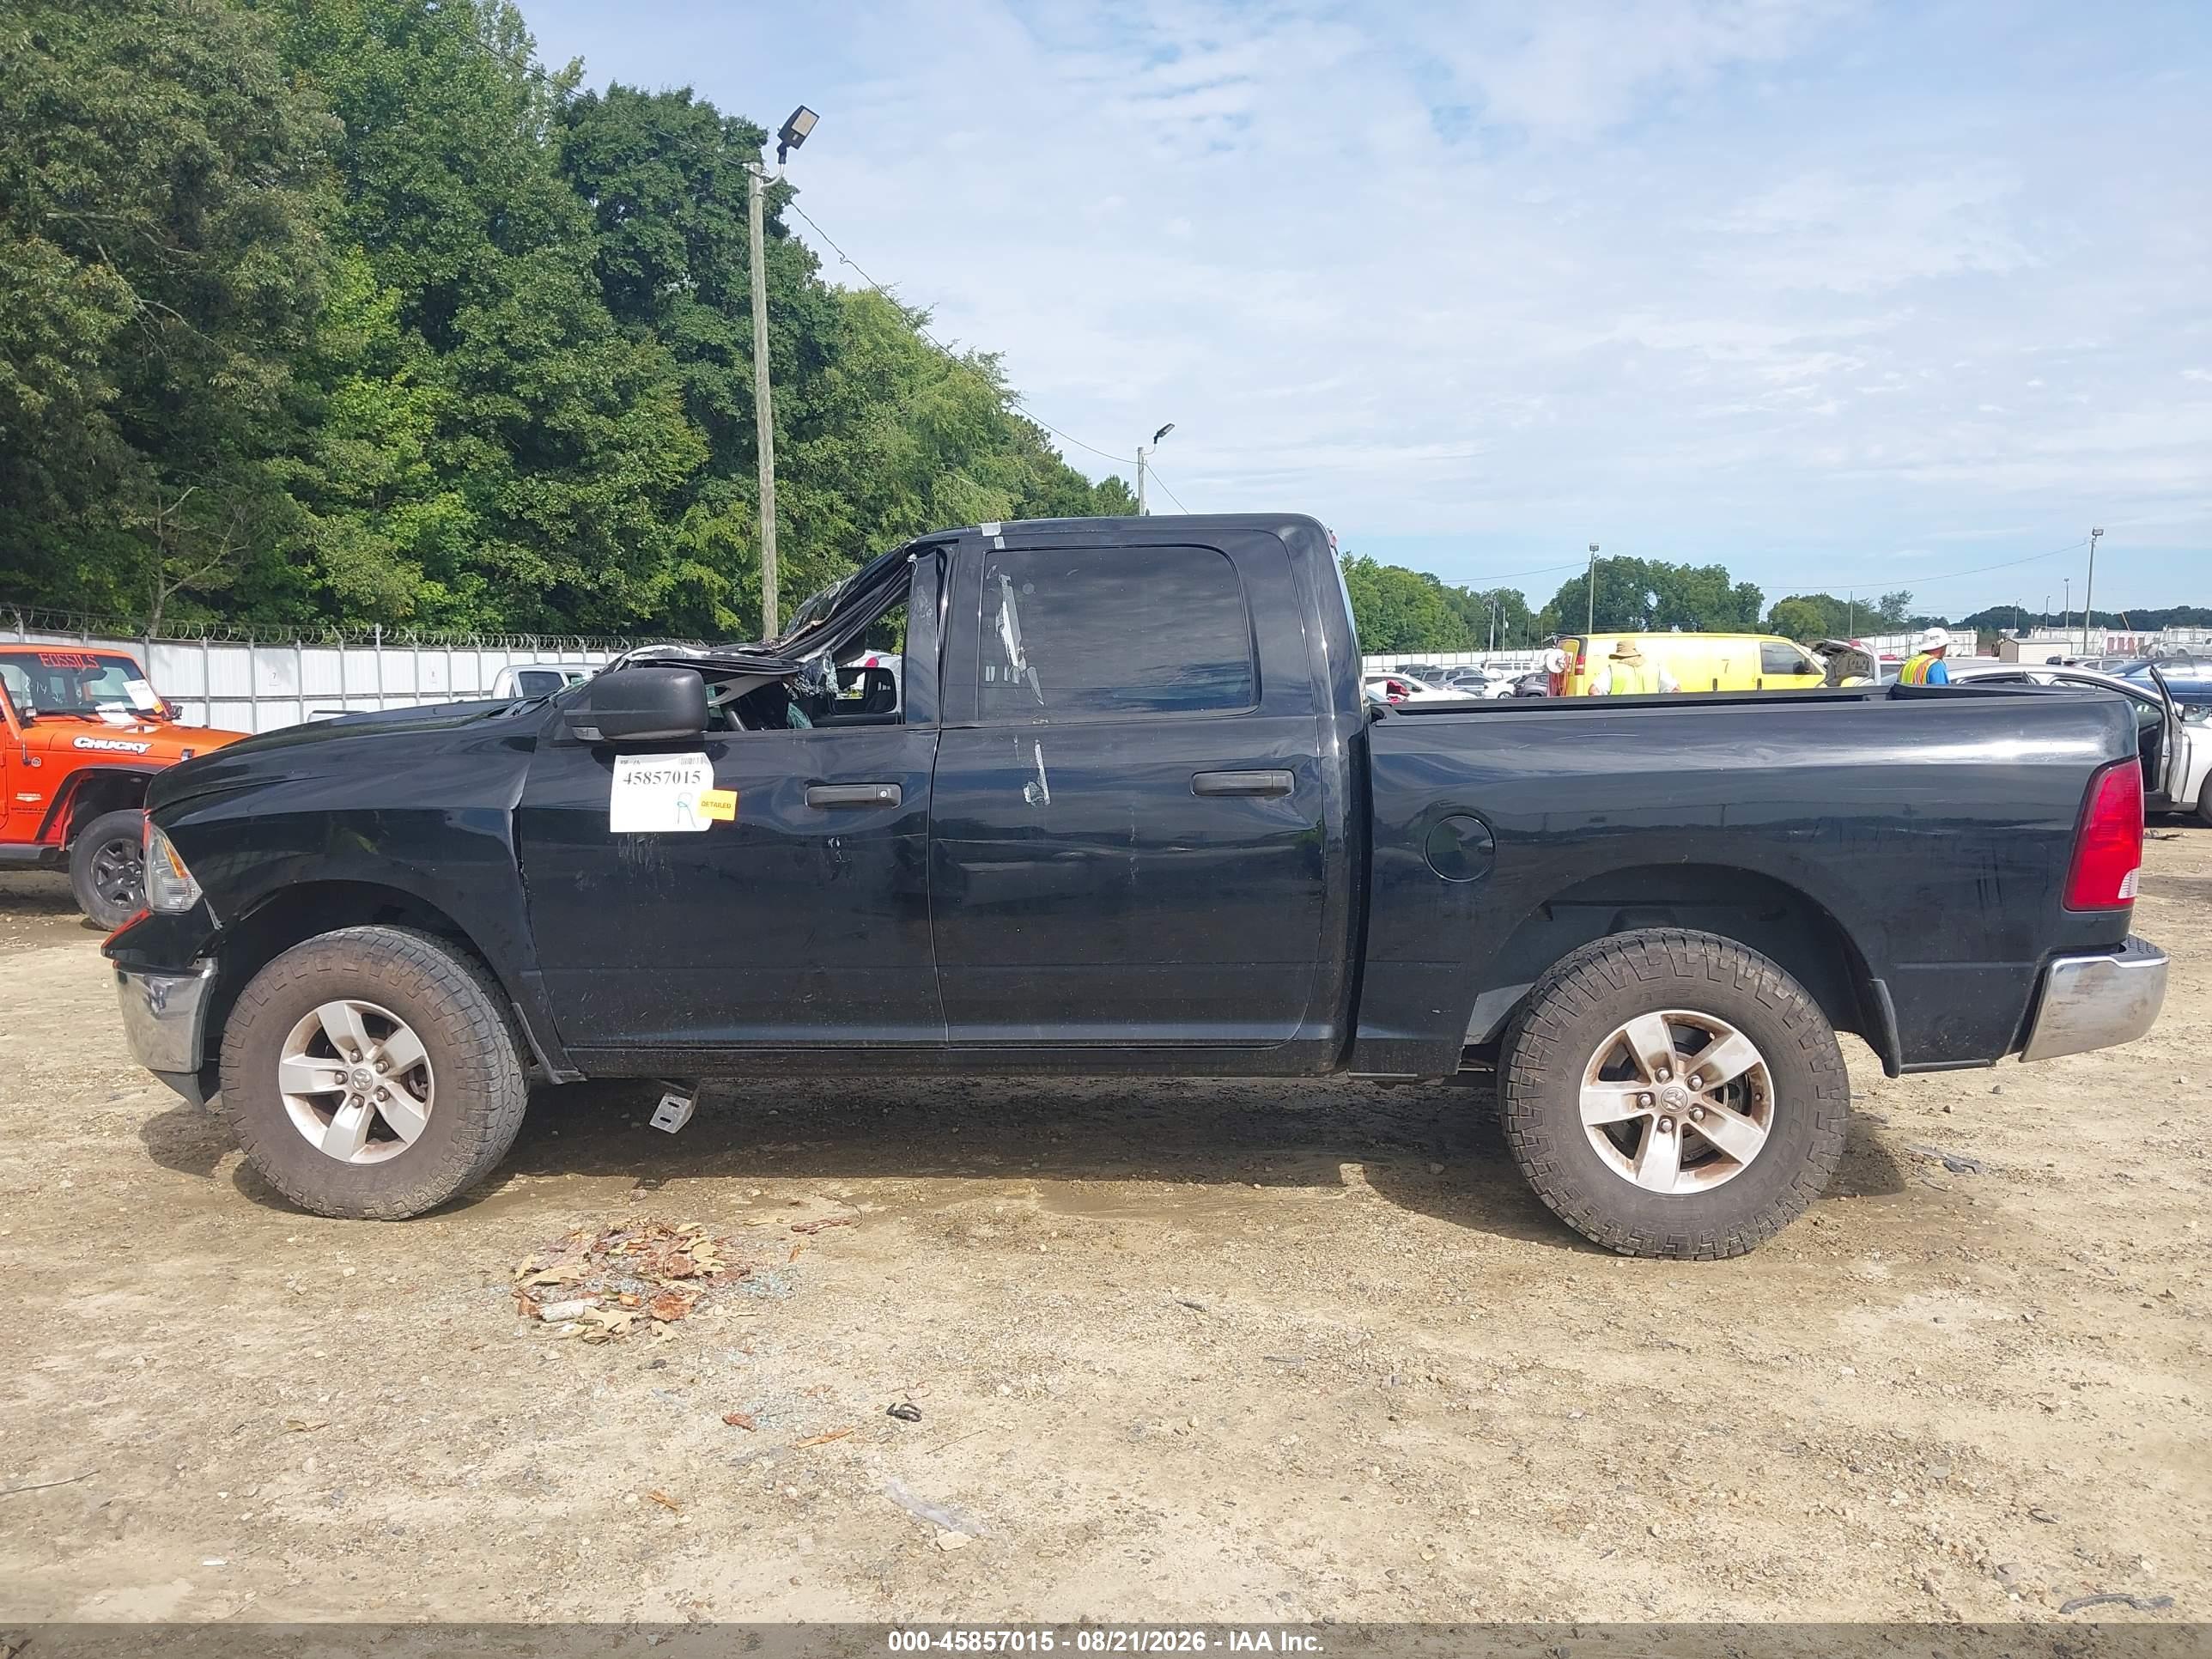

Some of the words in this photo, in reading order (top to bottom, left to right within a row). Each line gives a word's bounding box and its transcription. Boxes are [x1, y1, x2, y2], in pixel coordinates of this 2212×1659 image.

[1721, 659, 1730, 674] 7
[73, 736, 153, 755] CHUCKY
[623, 770, 702, 785] 45857015
[701, 800, 732, 809] DETAILED
